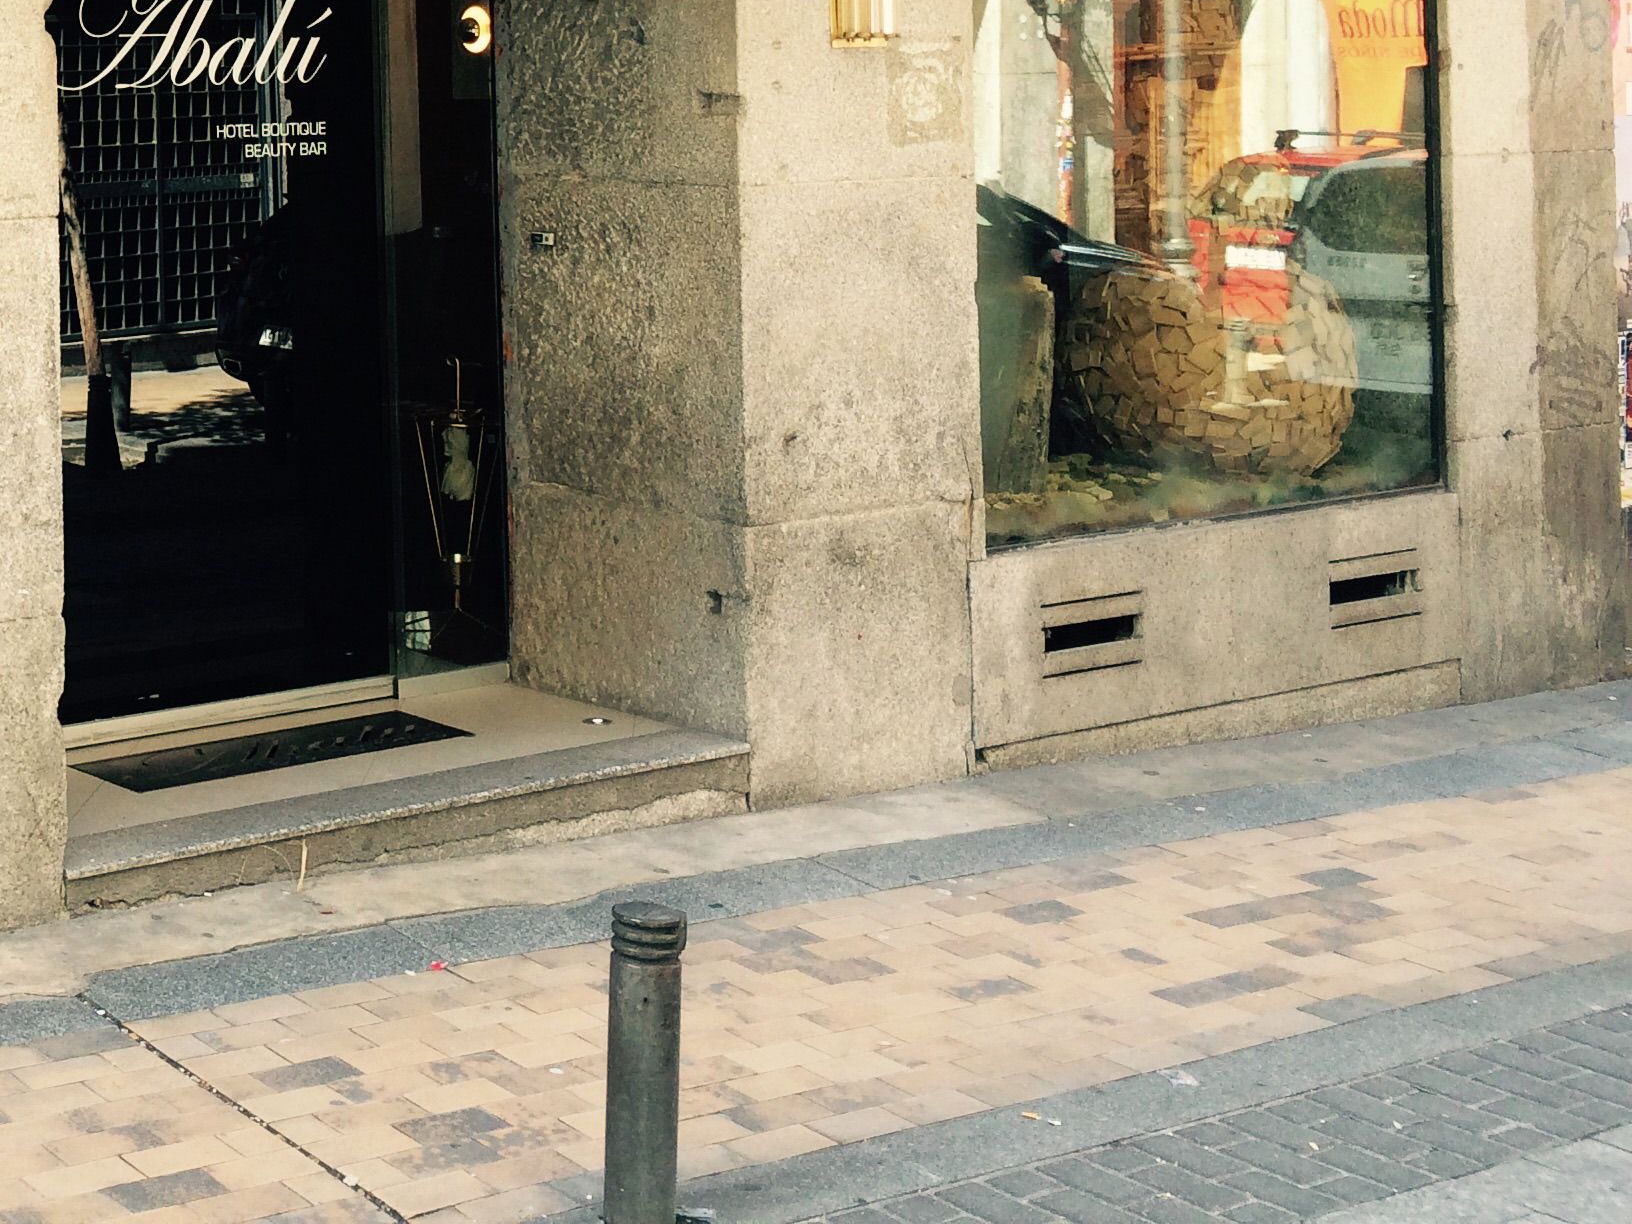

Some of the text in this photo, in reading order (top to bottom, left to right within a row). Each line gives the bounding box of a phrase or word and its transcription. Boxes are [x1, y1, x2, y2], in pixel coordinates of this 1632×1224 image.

[216, 121, 327, 139] HOTEL BOUTIQUE
[245, 142, 328, 158] BEAUTY BAR
